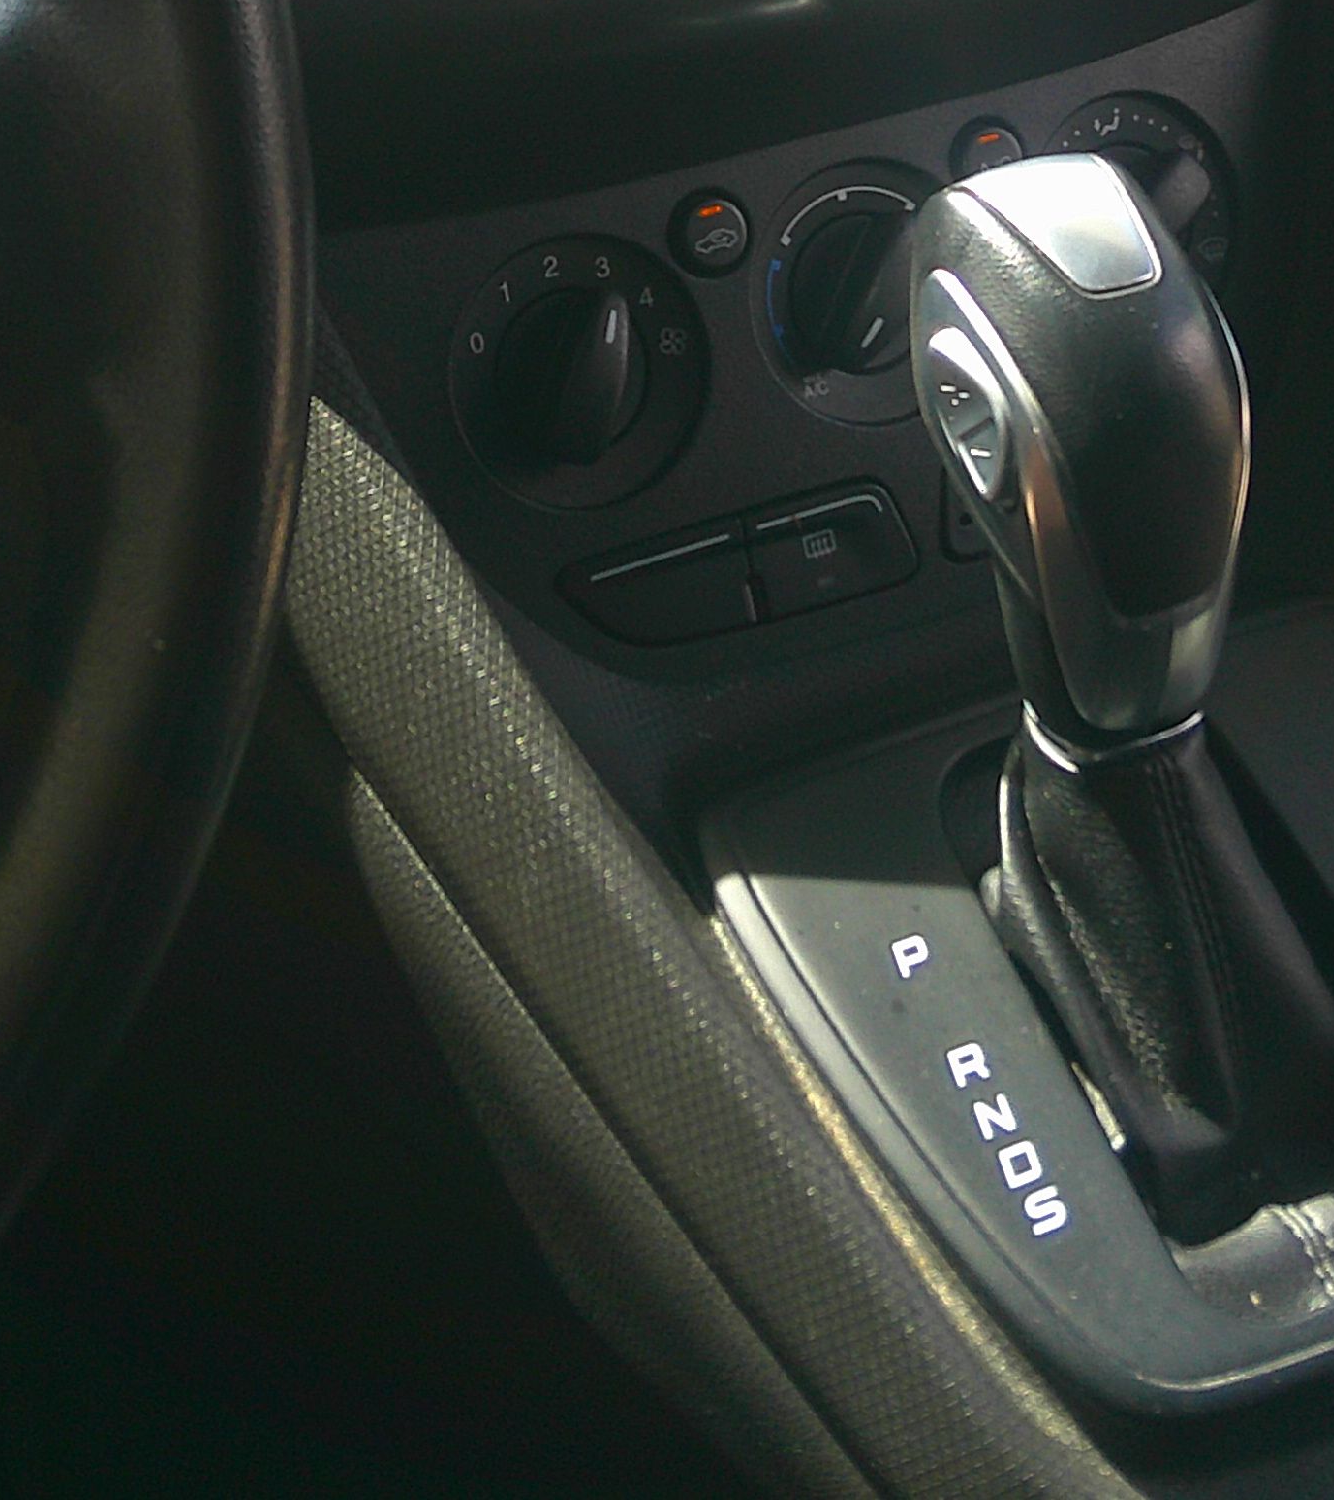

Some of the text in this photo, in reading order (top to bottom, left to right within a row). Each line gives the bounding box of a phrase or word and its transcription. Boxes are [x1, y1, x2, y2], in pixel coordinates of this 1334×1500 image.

[543, 255, 560, 278] 2
[595, 256, 611, 279] 3
[499, 280, 511, 303] 1
[639, 286, 655, 308] 4
[469, 332, 485, 354] 0
[890, 933, 1067, 1238] P R N D S
